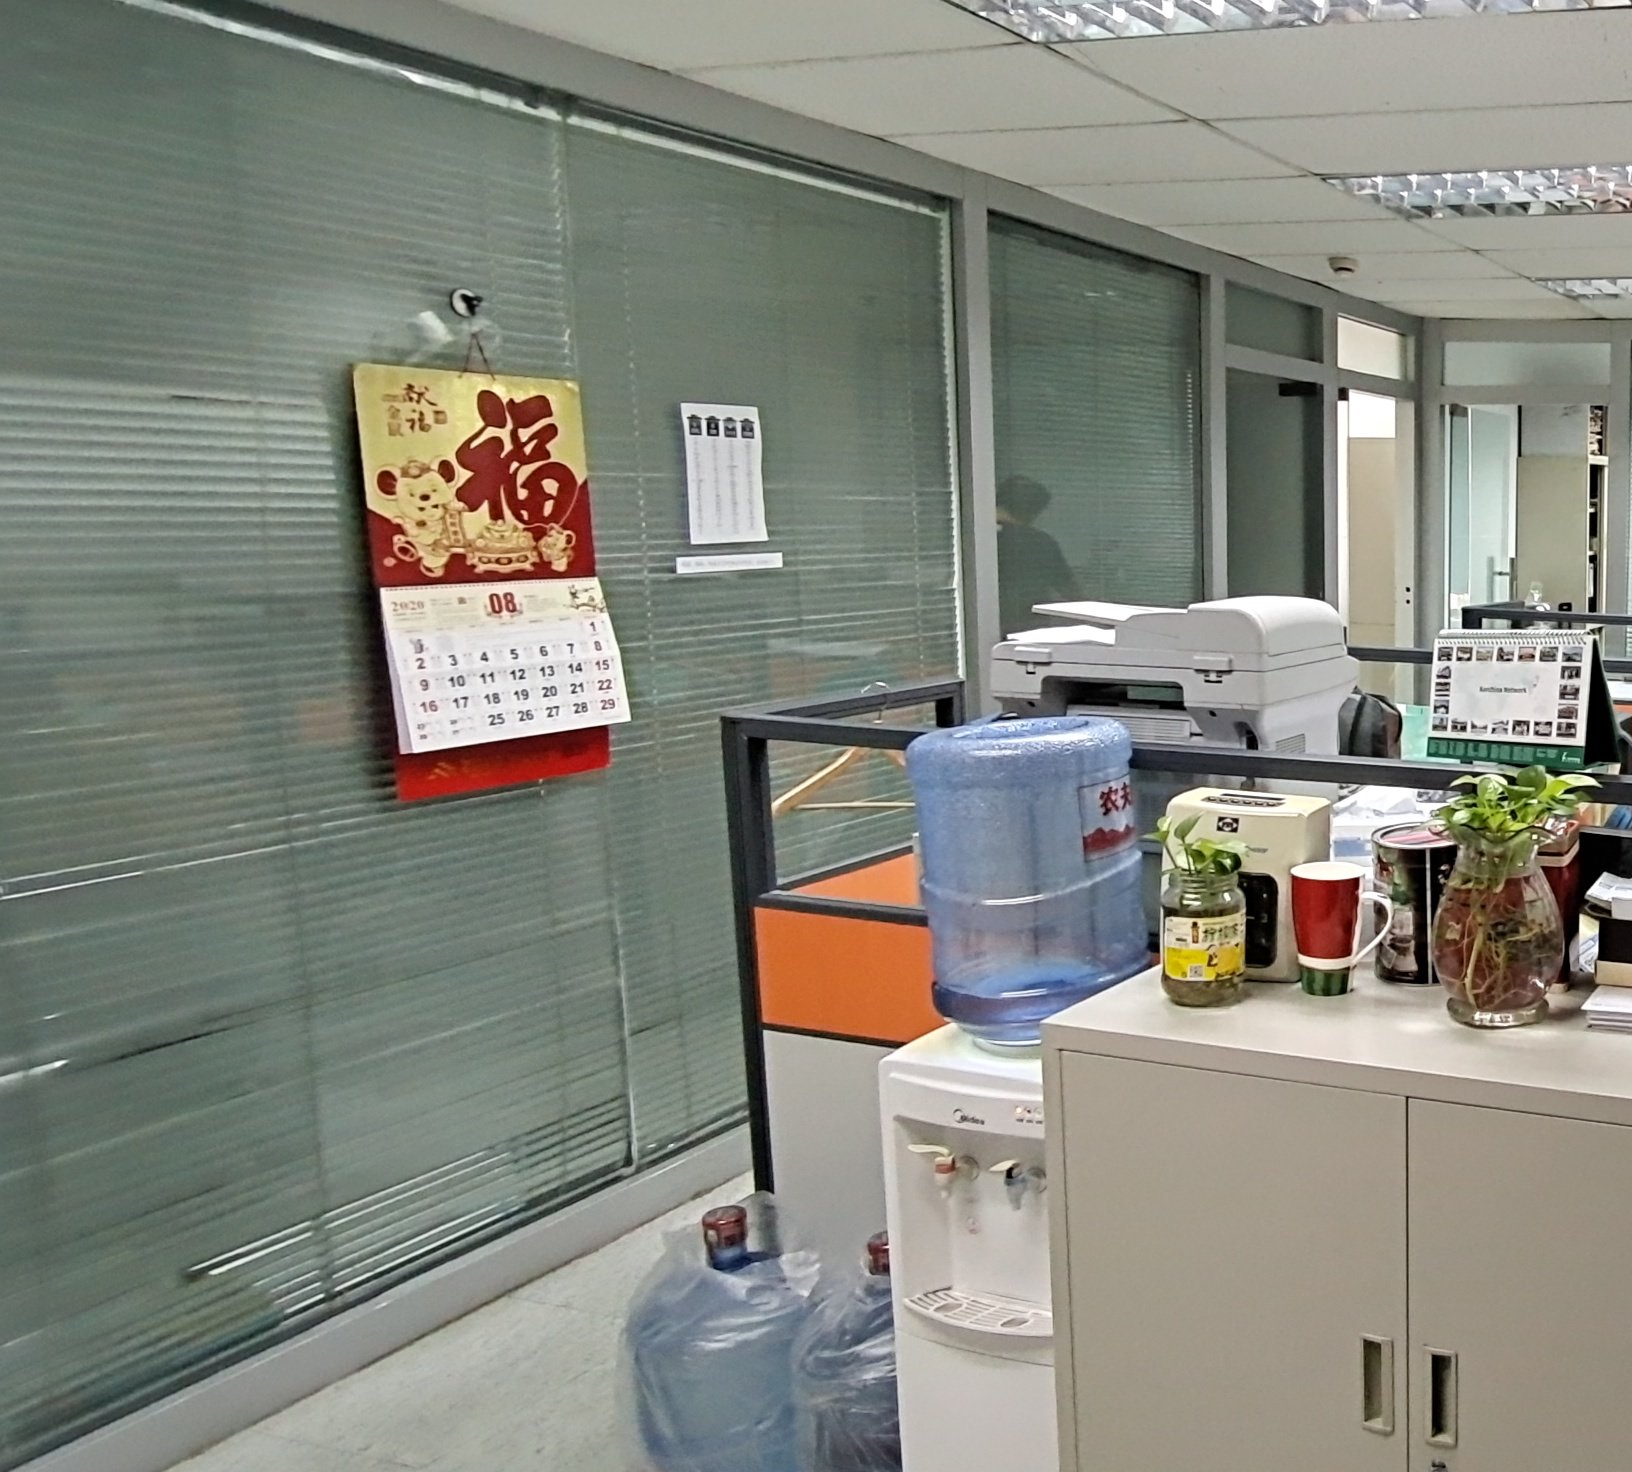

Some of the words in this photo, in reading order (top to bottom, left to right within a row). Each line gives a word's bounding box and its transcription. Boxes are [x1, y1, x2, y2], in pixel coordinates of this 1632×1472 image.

[456, 390, 578, 527] 福
[391, 600, 425, 612] 2020
[488, 592, 517, 615] 08
[589, 621, 597, 632] 1
[415, 658, 426, 670] 2
[448, 654, 458, 667] 3
[480, 651, 489, 663] 4
[510, 648, 519, 660] 5
[539, 645, 549, 657] 6
[566, 643, 575, 655] 7
[594, 640, 602, 652] 8
[420, 679, 429, 692] 9
[448, 674, 466, 688] 10
[480, 671, 495, 685] 11
[509, 668, 526, 681] 12
[539, 665, 555, 678] 13
[567, 662, 583, 674] 14
[595, 659, 610, 671] 15
[419, 700, 439, 713] 16
[452, 696, 469, 709] 17
[484, 692, 501, 705] 18
[513, 689, 529, 701] 19
[541, 685, 558, 698] 20
[570, 682, 585, 694] 21
[597, 678, 613, 691] 22
[487, 713, 505, 726] 25
[517, 709, 534, 722] 26
[545, 705, 560, 718] 27
[572, 702, 588, 714] 28
[600, 698, 616, 711] 29
